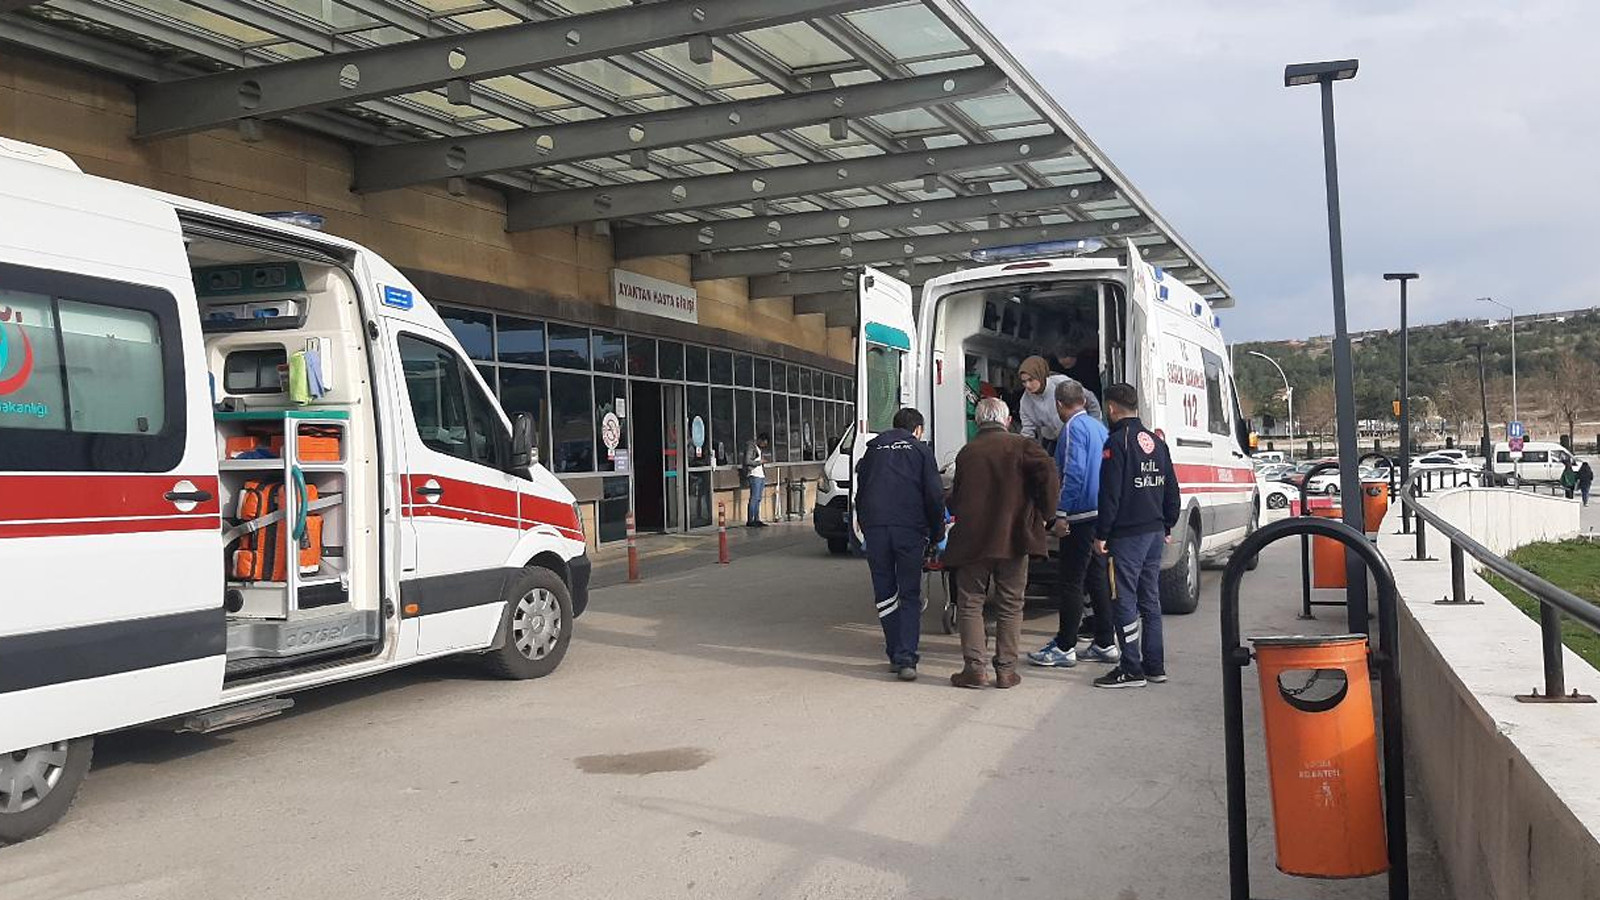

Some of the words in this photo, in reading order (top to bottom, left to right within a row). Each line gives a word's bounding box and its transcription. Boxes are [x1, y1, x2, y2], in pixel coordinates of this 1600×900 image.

[618, 281, 651, 301] AYAKTAN
[653, 292, 675, 309] HASTA
[0, 400, 47, 418] akanlığı
[1183, 393, 1197, 427] 112
